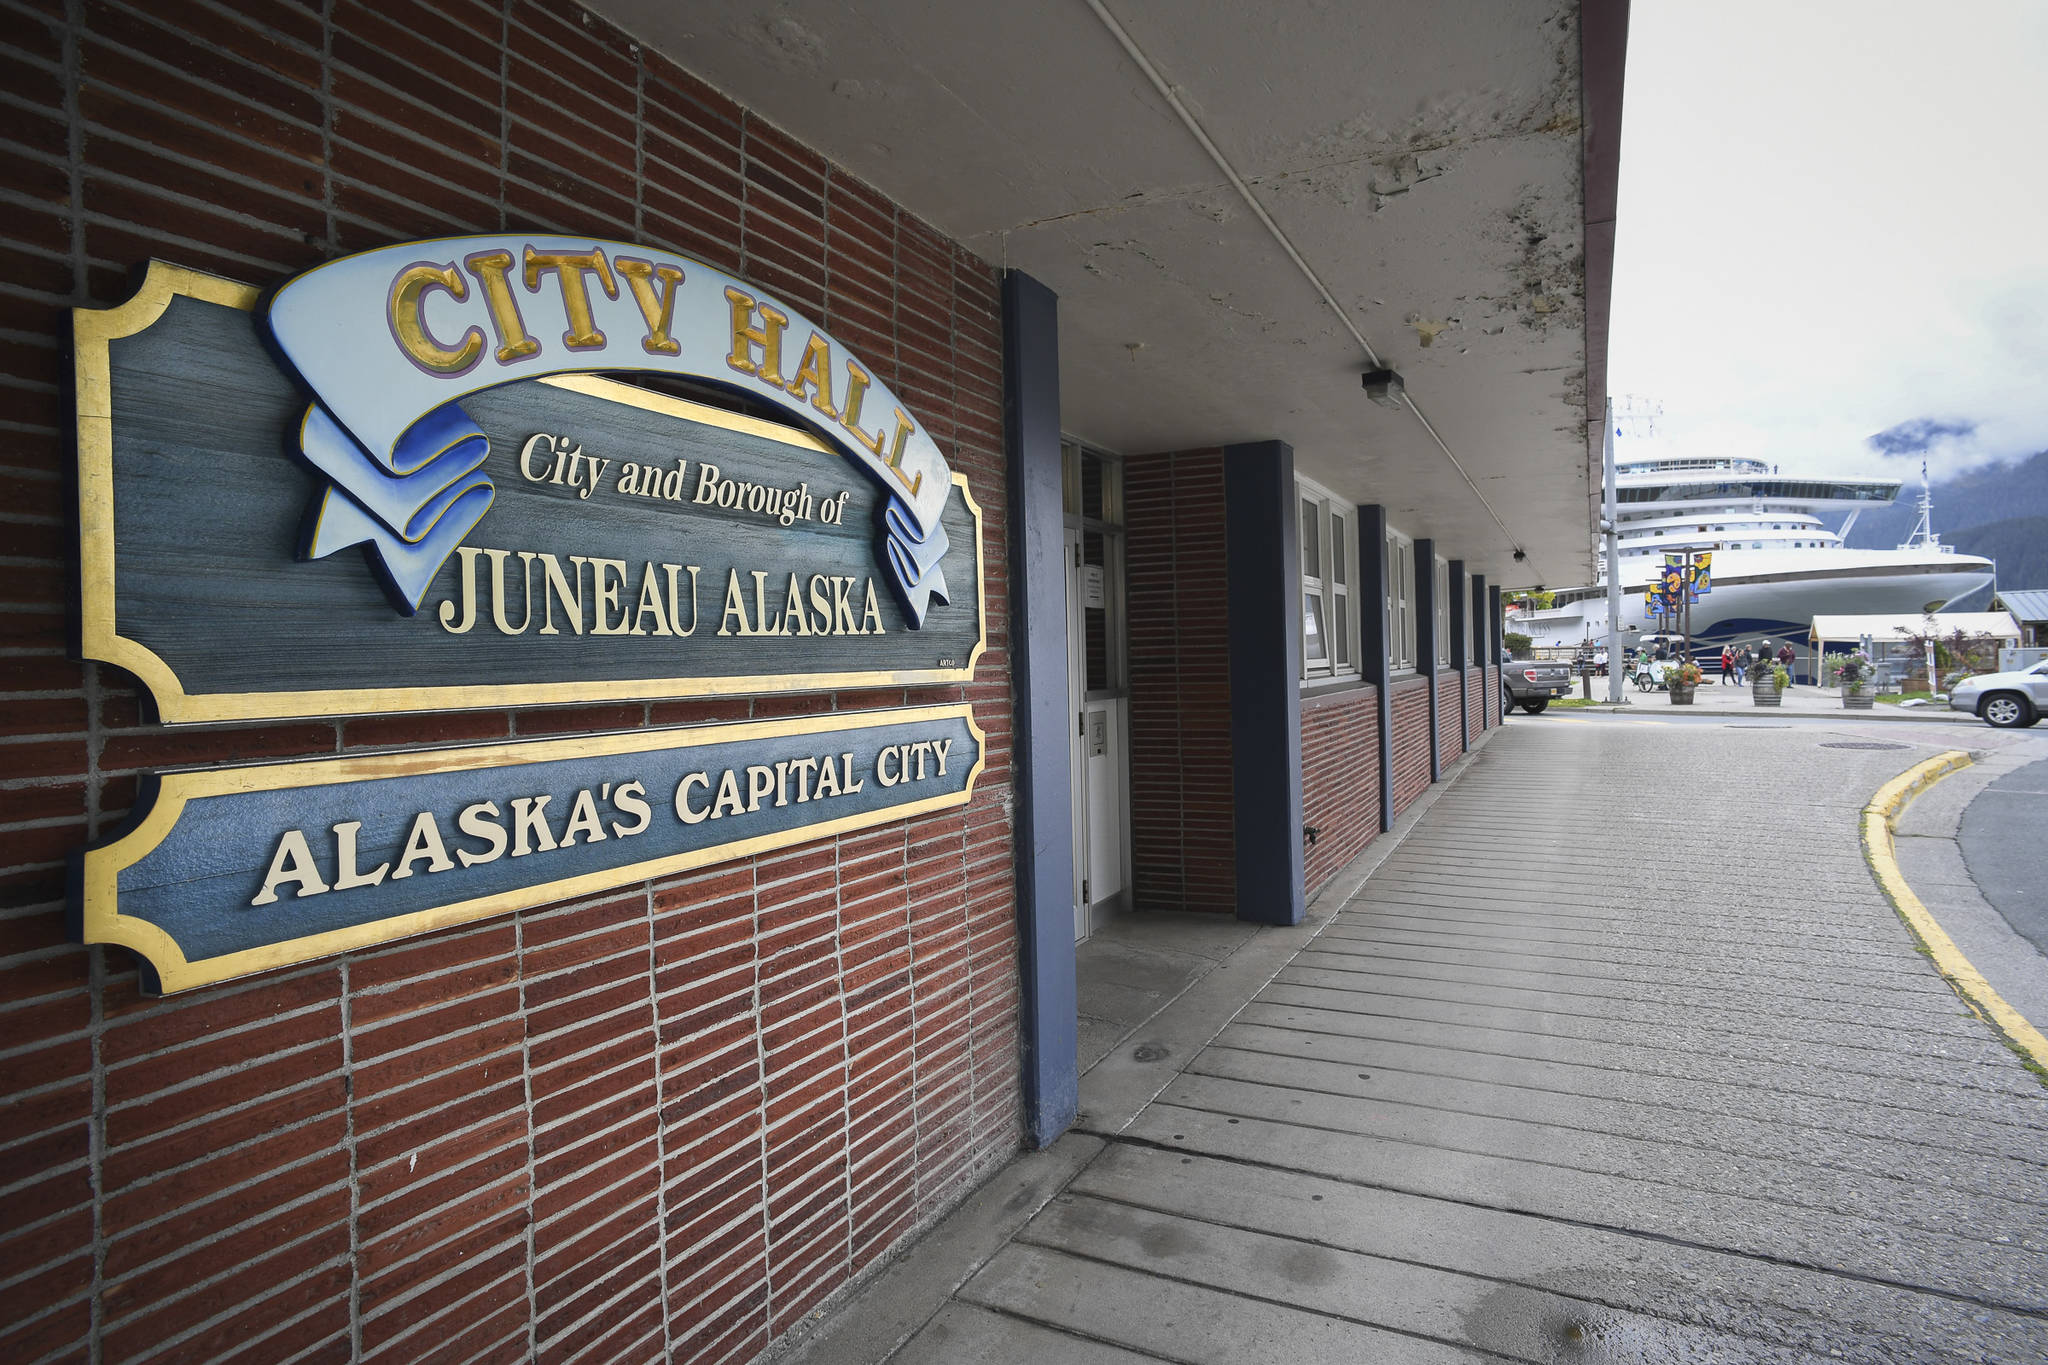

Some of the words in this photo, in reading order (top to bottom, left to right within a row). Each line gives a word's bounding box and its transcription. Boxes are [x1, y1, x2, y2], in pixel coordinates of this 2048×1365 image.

[387, 244, 685, 379] CITY
[724, 284, 923, 499] HALL
[520, 432, 611, 501] City
[616, 458, 687, 502] and
[692, 462, 813, 527] Borough
[819, 491, 850, 526] of
[438, 546, 701, 637] JUNEAU
[716, 566, 886, 637] ALASKA
[250, 780, 652, 906] ALASKA'S
[675, 753, 864, 825] CAPITAL
[876, 738, 953, 789] CITY
